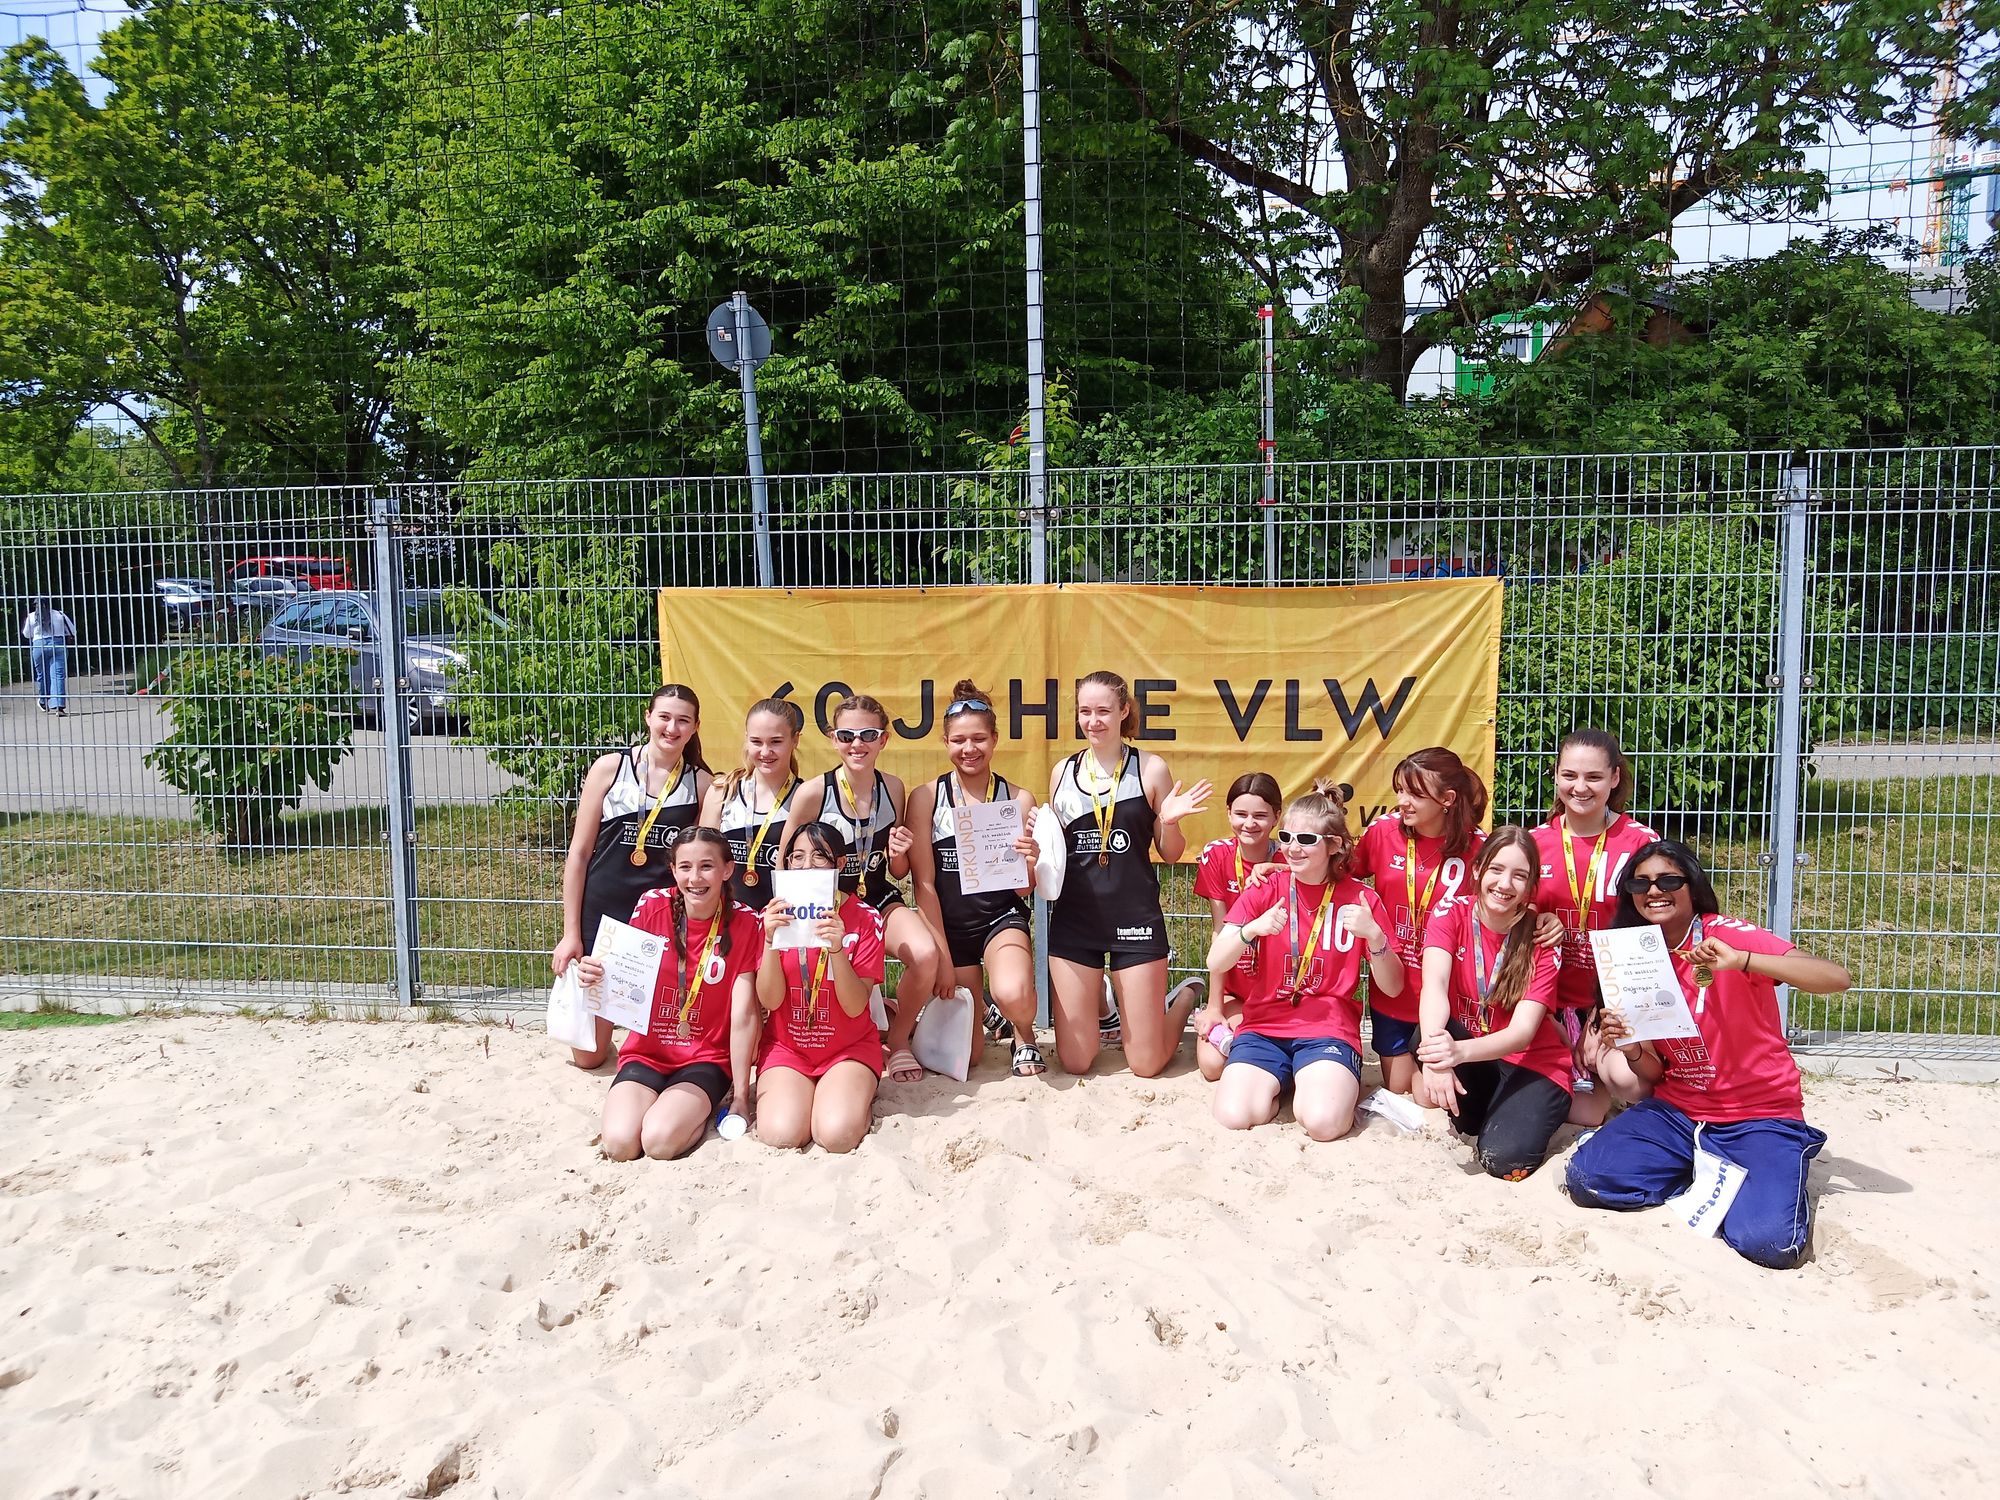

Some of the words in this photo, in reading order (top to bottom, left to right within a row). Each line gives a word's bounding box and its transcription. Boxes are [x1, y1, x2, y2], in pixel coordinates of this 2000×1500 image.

[892, 678, 1177, 741] JHE
[1213, 676, 1417, 742] VLW
[958, 809, 980, 890] URKUNDE
[1441, 857, 1466, 902] 9
